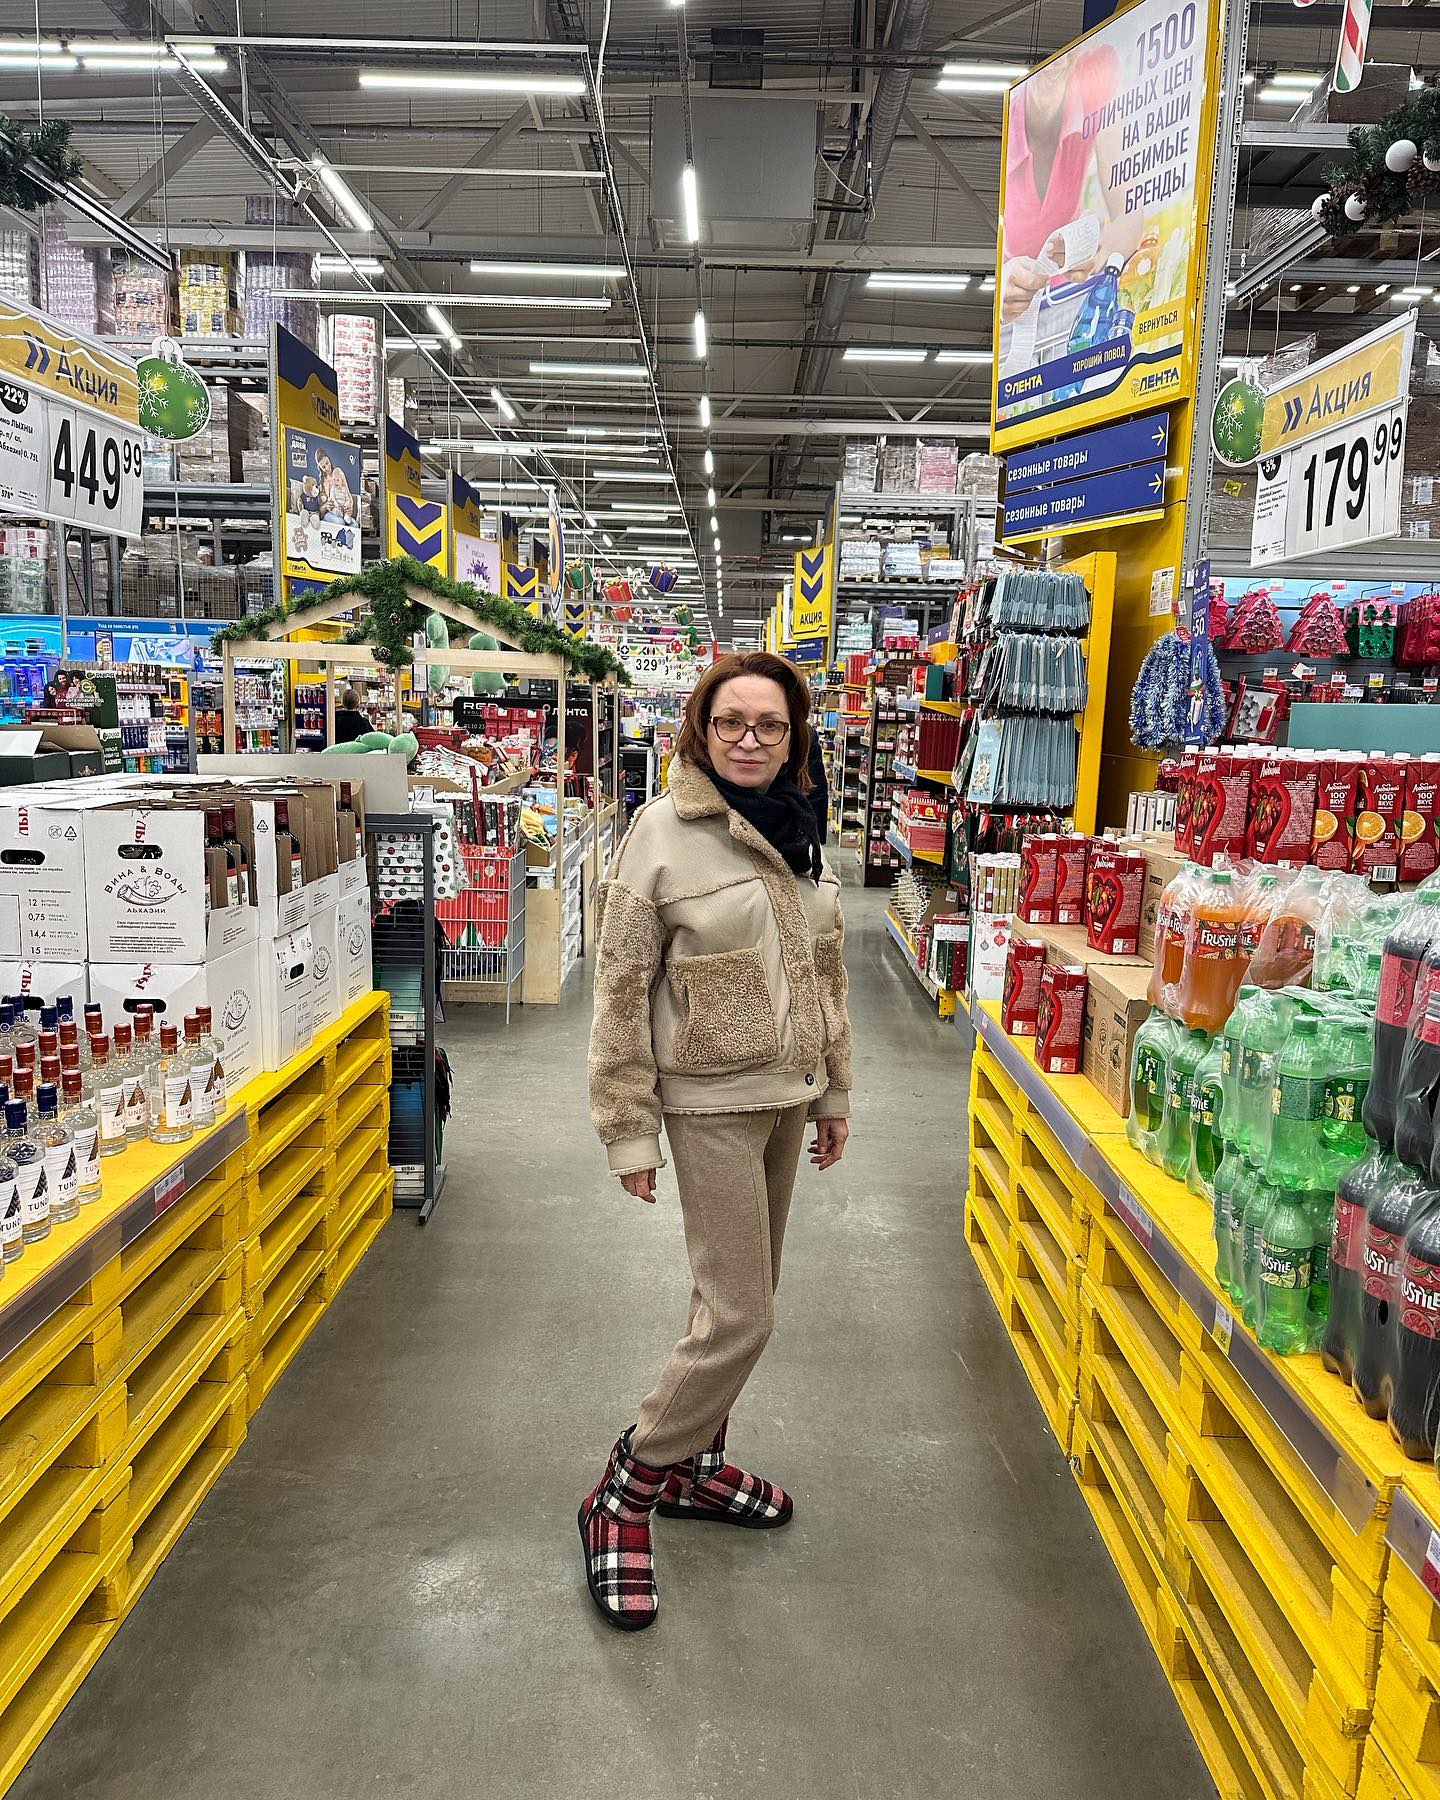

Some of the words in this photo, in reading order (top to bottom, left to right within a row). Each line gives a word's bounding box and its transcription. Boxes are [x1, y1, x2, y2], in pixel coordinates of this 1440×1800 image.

[1136, 2, 1196, 76] 1500
[1081, 75, 1159, 141] ОТЛИЧНЫХ
[1163, 55, 1194, 96] ЦЕН
[1121, 120, 1141, 151] НА
[1145, 91, 1192, 139] ВАШИ
[1108, 126, 1190, 191] ЛЮБИМЫЕ
[1124, 162, 1187, 215] БРЕНДЫ
[1138, 310, 1178, 335] ВЕРНУТЬСЯ
[1072, 352, 1103, 373] ХОРОШИЙ
[1103, 345, 1126, 363] ПОВОД
[55, 344, 118, 405] Акция
[1012, 374, 1043, 397] ЛЕНТА
[1139, 367, 1179, 392] ЛЕНТА
[1305, 371, 1373, 425] Акция
[54, 419, 120, 510] 449
[123, 439, 142, 478] 99
[1007, 461, 1051, 482] сезонные
[1053, 450, 1089, 470] товары
[1304, 437, 1369, 532] 179
[1374, 417, 1402, 466] 99
[1005, 504, 1048, 523] сезонные
[1050, 494, 1086, 513] товары
[800, 611, 822, 625] АКЦИЯ
[636, 659, 657, 671] 329
[552, 708, 589, 716] лнта
[28, 898, 38, 907] 12
[28, 912, 46, 922] 0,75
[30, 929, 46, 939] 14,4
[31, 947, 41, 955] 15
[1261, 1252, 1291, 1273] USTYLE
